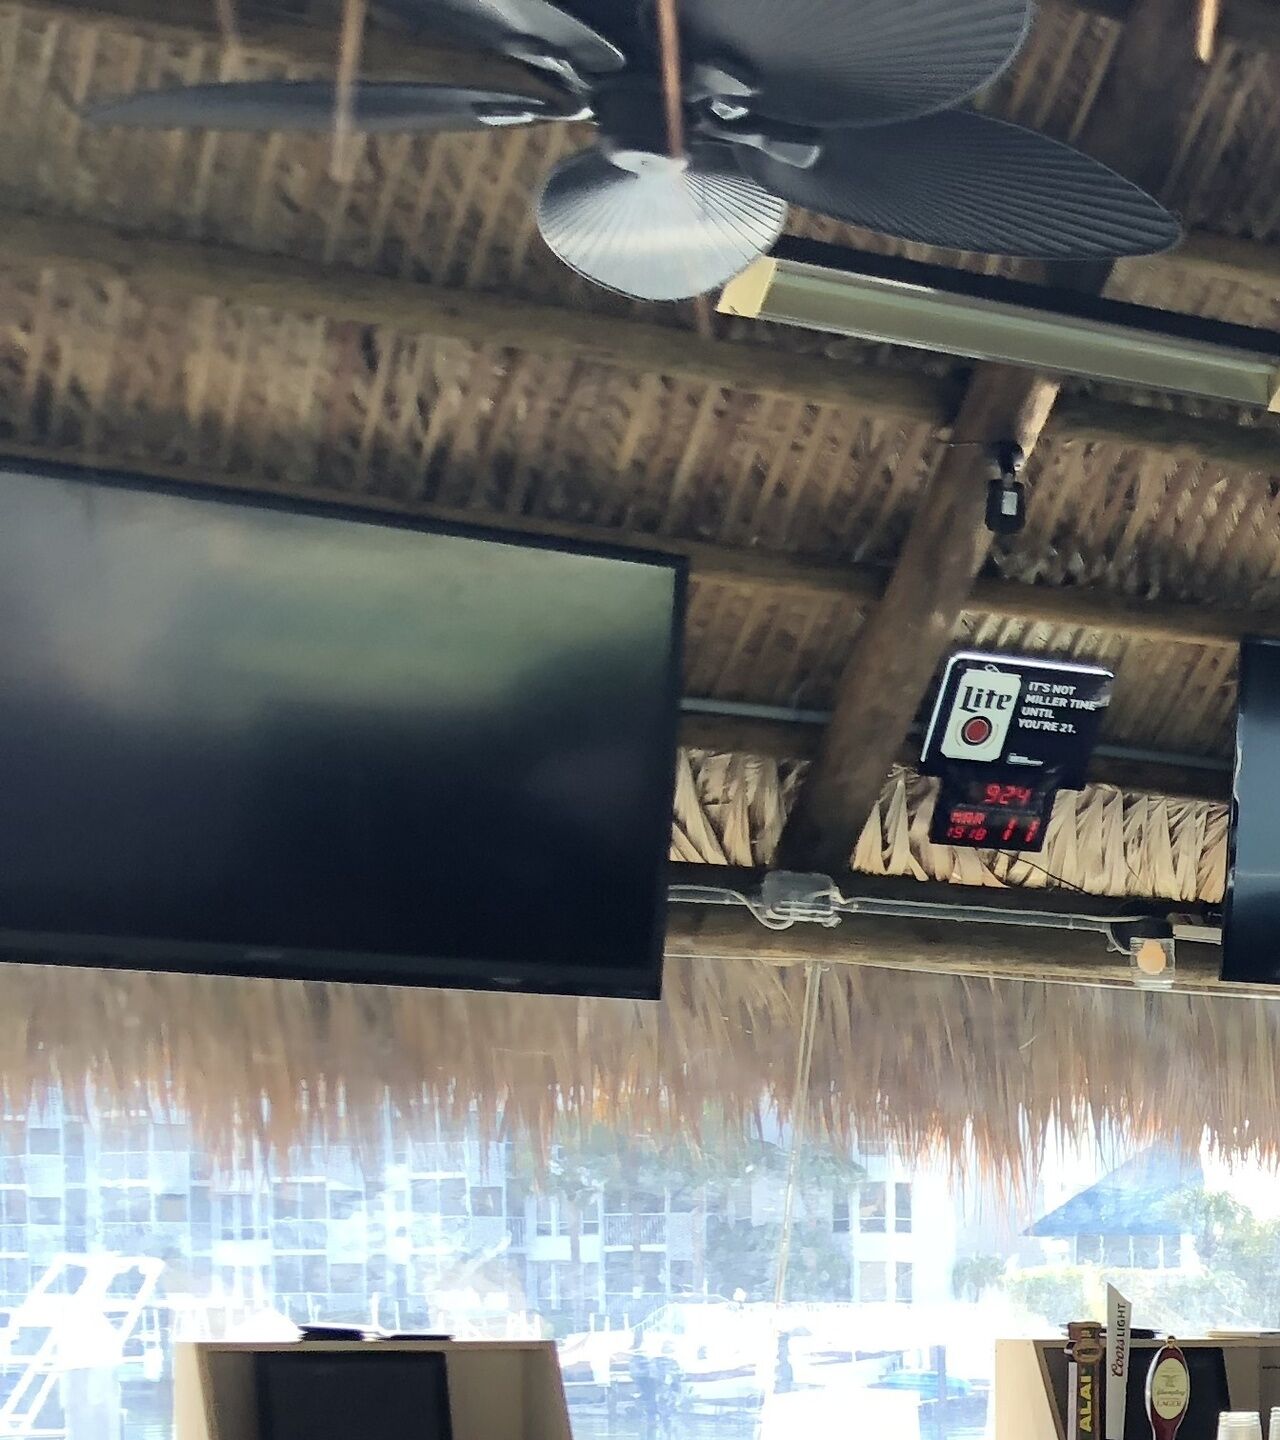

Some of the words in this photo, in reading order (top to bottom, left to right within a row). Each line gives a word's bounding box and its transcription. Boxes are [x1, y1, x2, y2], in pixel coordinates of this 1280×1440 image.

[959, 686, 1012, 712] Lite
[1028, 681, 1051, 693] IT'S
[1052, 684, 1077, 696] NOT
[1021, 707, 1055, 719] UNTIL
[1025, 694, 1068, 707] MILLER
[1070, 699, 1097, 711] TIME
[1018, 718, 1059, 732] YOU'RE
[1116, 1303, 1126, 1338] LIGHT
[1112, 1340, 1124, 1378] Coors
[1079, 1375, 1093, 1433] ALAI
